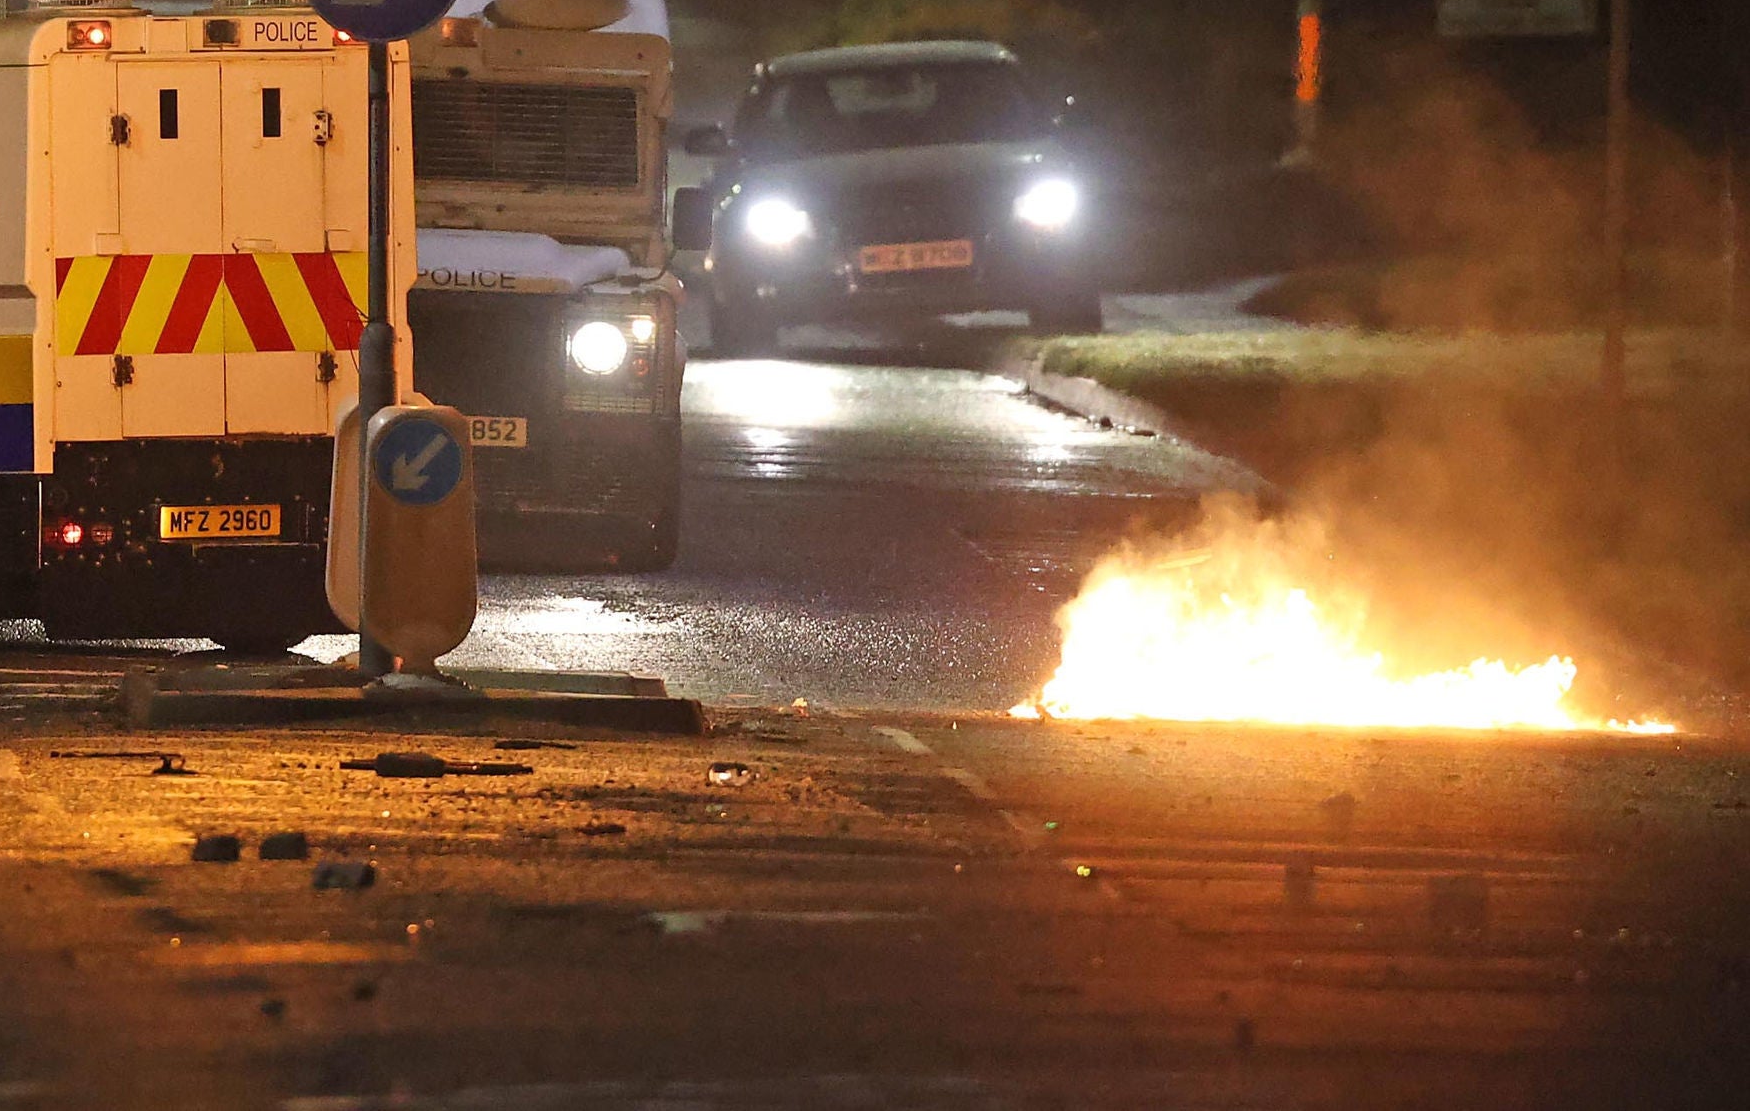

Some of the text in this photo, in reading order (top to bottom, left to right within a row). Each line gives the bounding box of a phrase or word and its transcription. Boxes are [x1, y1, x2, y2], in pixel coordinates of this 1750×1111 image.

[254, 21, 318, 42] POLICE
[471, 419, 517, 442] 852
[169, 509, 273, 533] MFZ 2960
